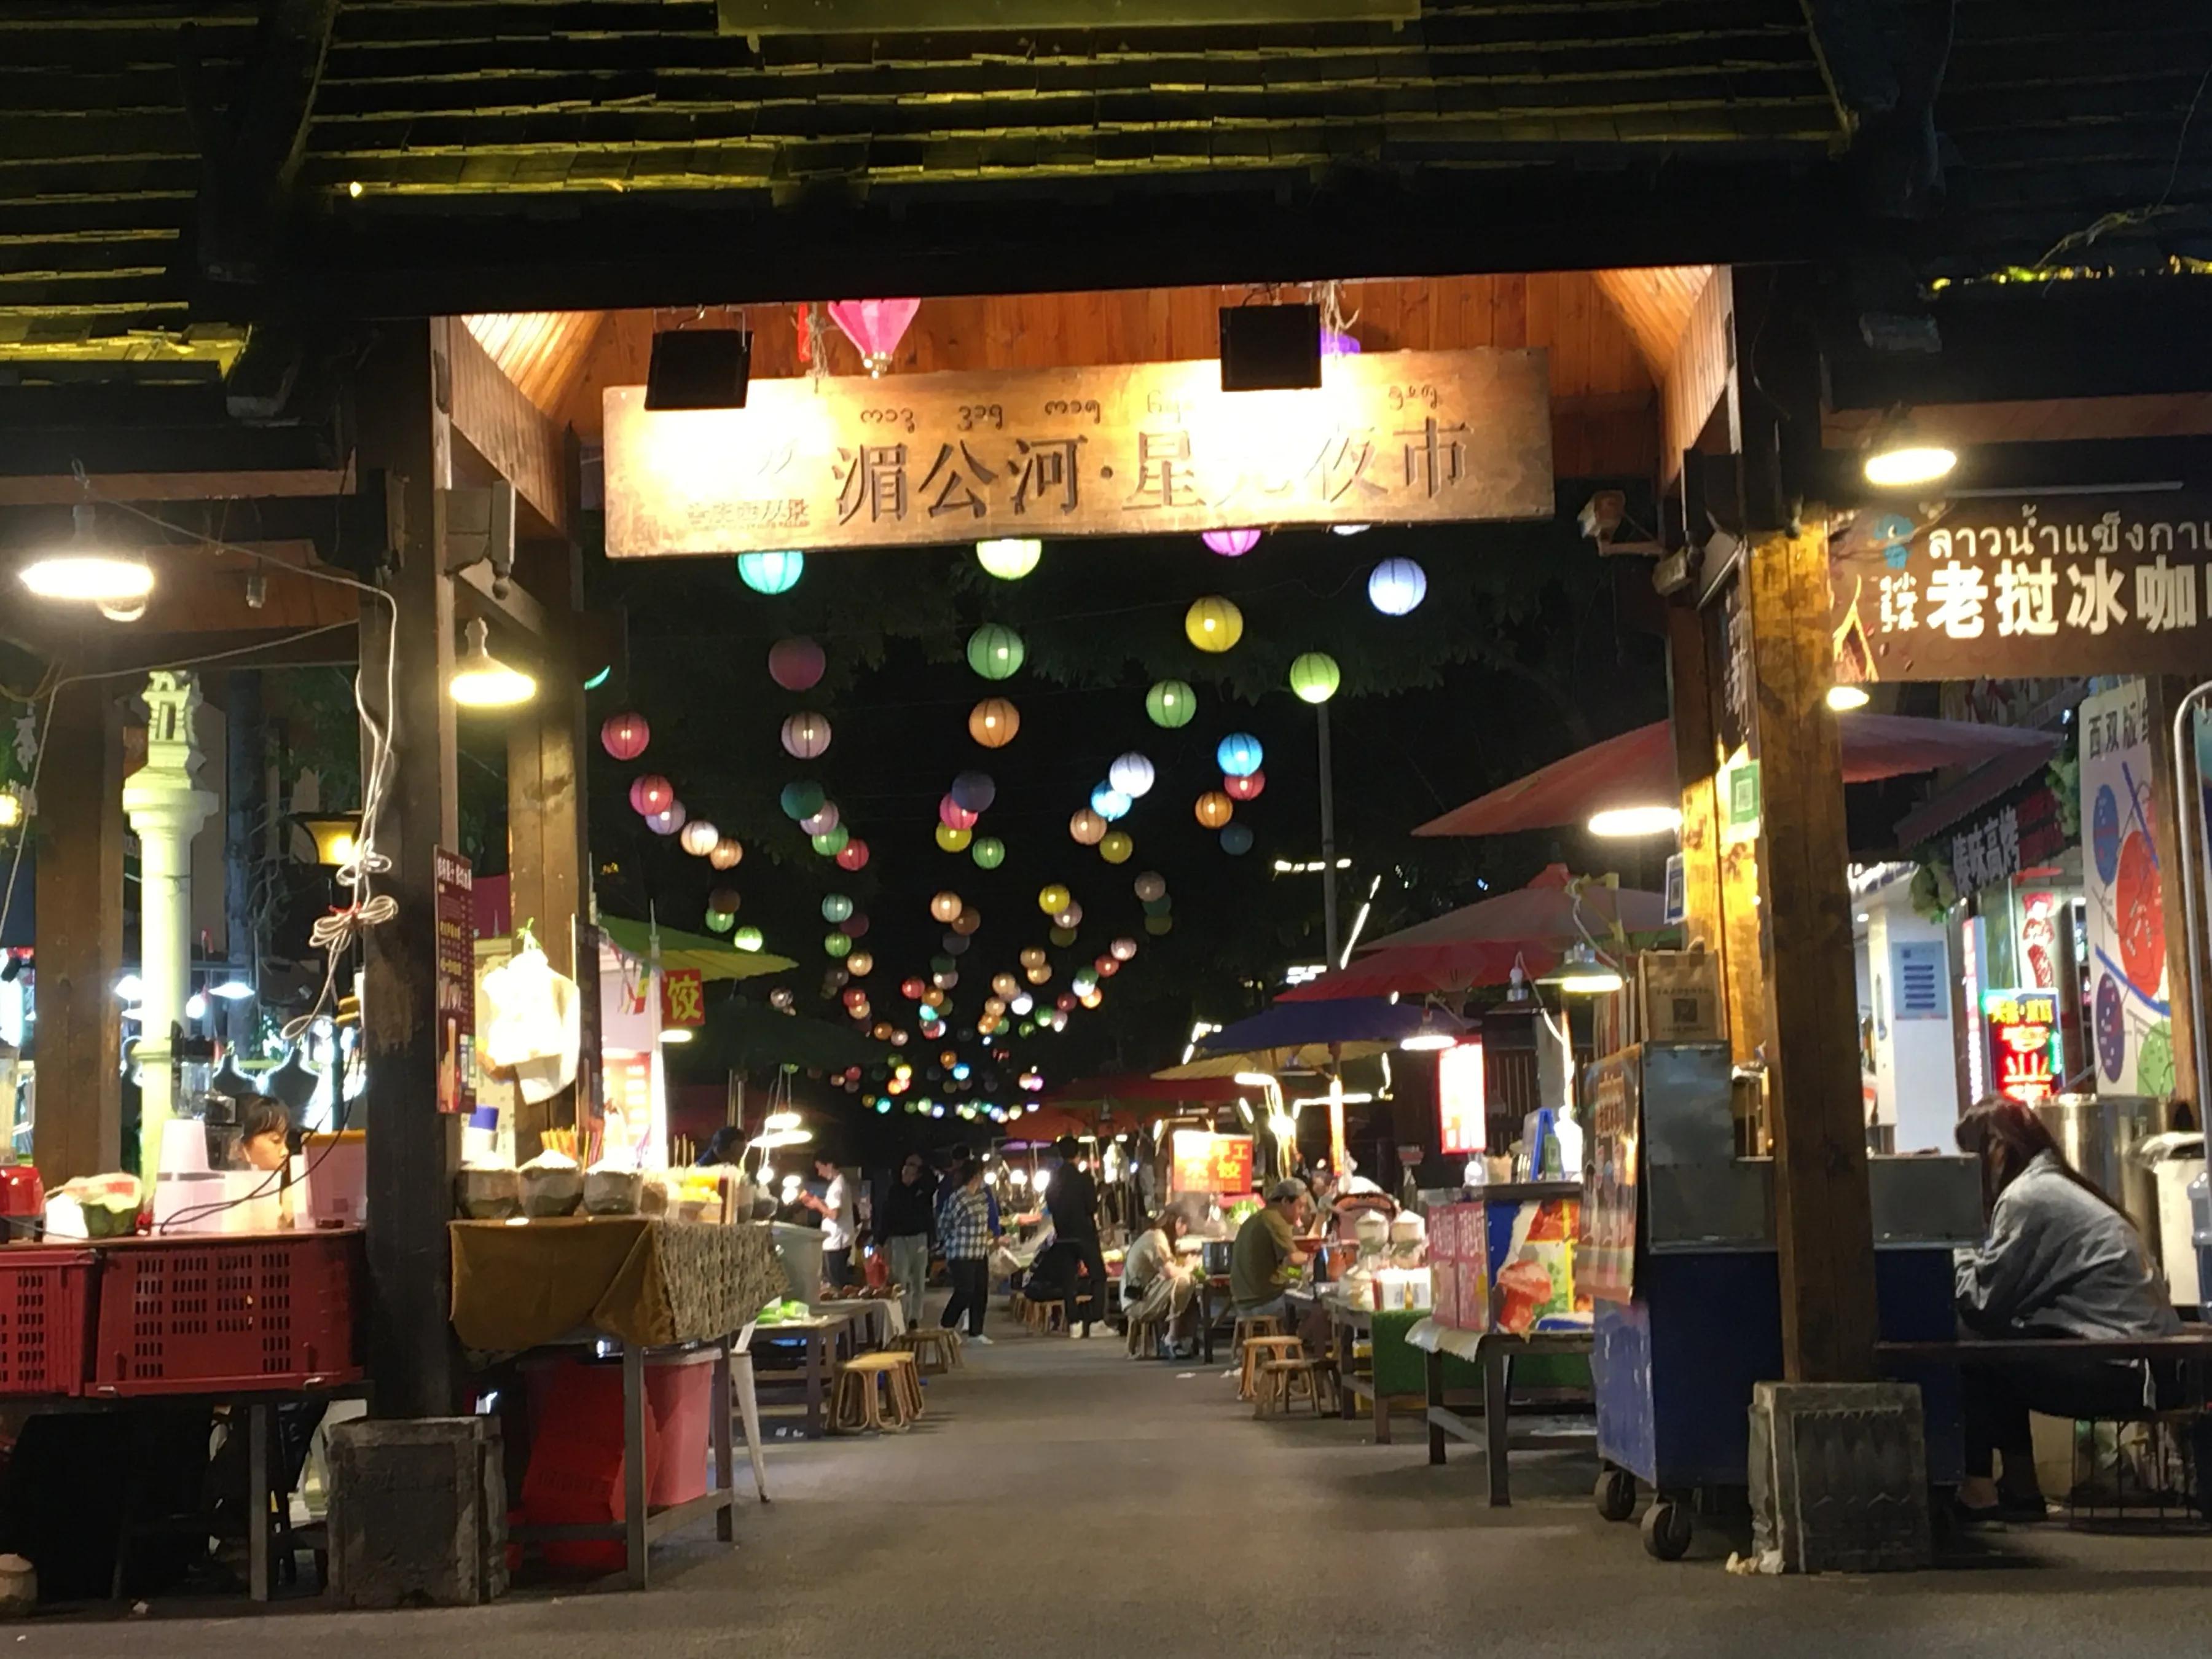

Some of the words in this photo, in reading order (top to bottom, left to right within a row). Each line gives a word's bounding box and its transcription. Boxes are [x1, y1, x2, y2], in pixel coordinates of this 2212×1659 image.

[831, 415, 1475, 527] 湄公河·星夜市
[1926, 554, 2212, 638] 老挝冰咖
[667, 974, 702, 1021] 饺
